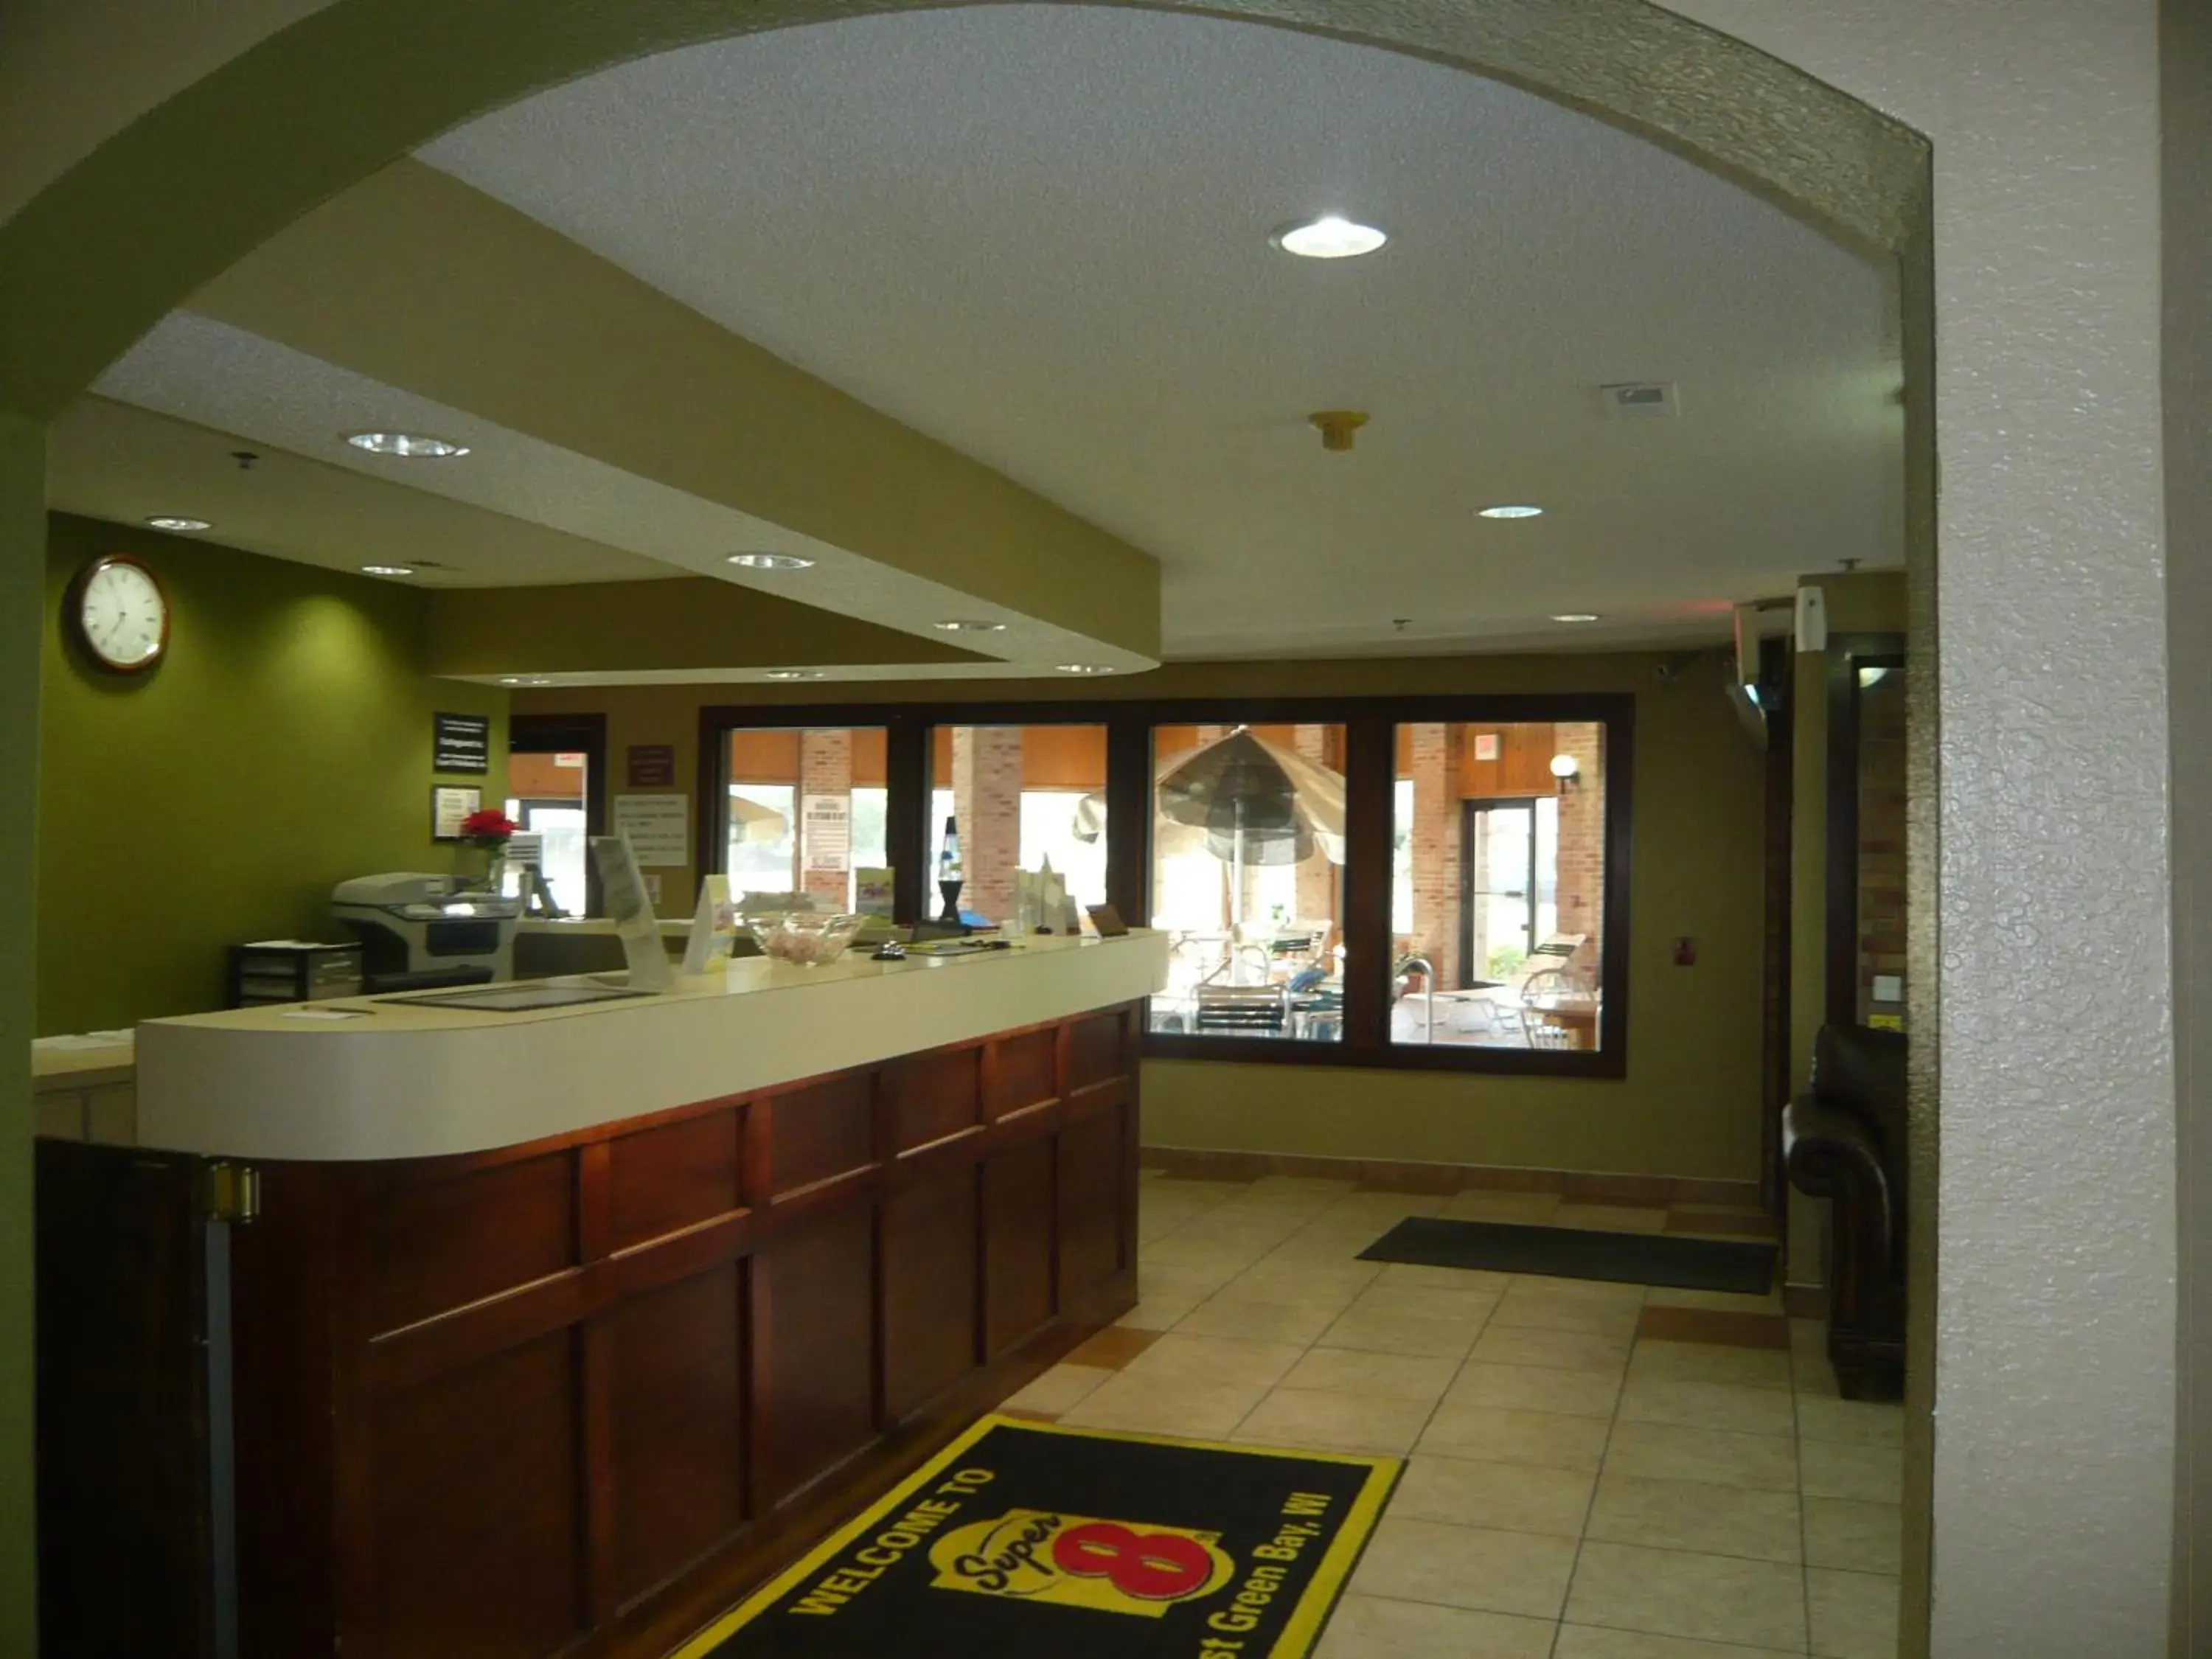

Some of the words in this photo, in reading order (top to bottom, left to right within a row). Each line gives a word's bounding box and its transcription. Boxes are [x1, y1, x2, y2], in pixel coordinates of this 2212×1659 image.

[1280, 1492, 1332, 1515] WI
[788, 1499, 961, 1615] WELCOME
[936, 1468, 994, 1494] TO
[953, 1514, 1062, 1591] Super
[1052, 1523, 1213, 1601] 8
[1252, 1522, 1322, 1561] Bay,
[1207, 1565, 1287, 1632] Green
